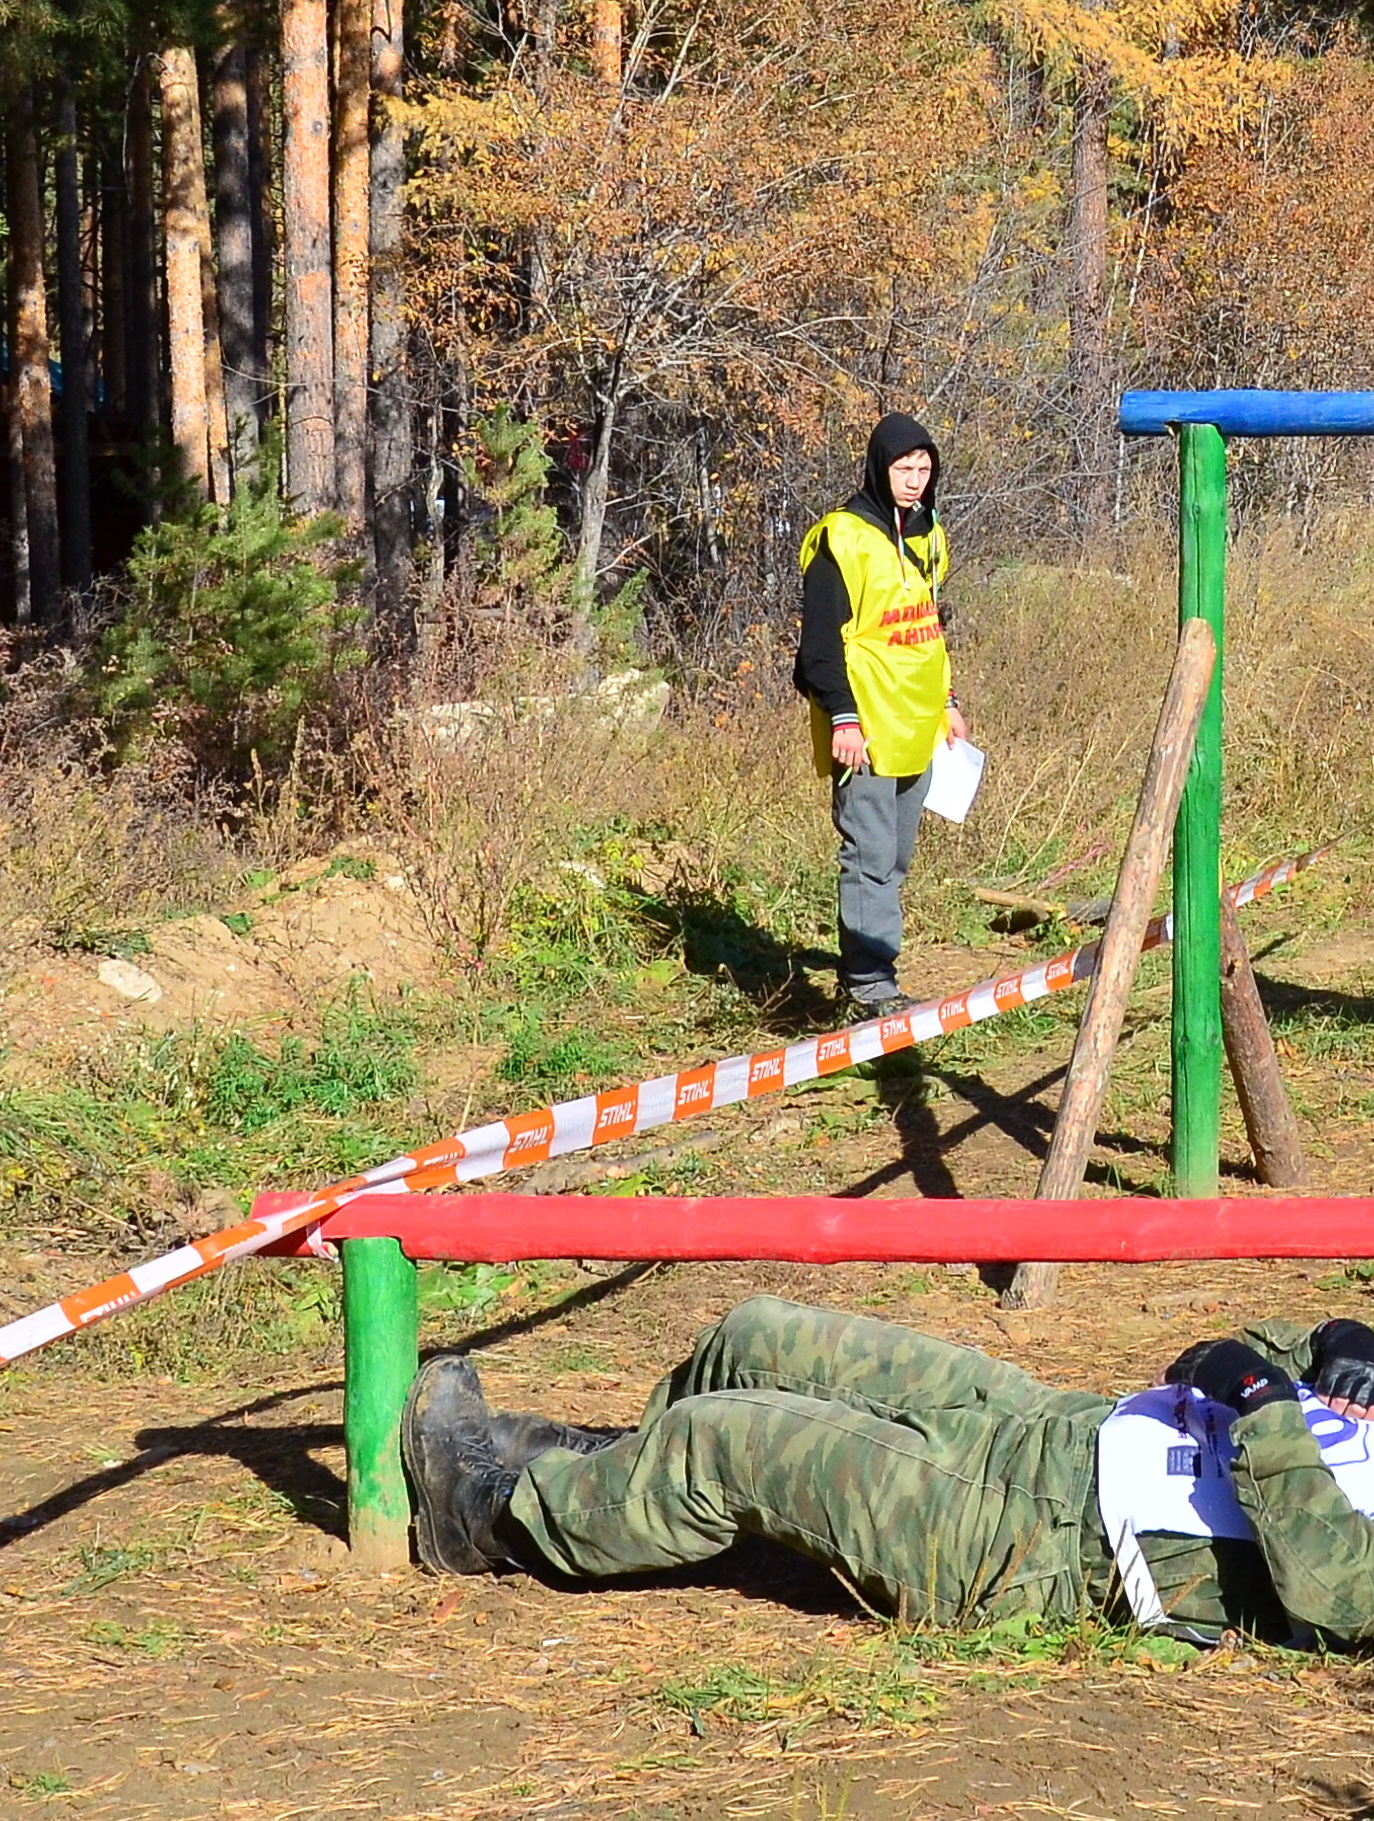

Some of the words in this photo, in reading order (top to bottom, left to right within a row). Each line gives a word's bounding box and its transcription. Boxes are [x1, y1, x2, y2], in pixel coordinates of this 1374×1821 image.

[818, 1039, 846, 1061] STIHL
[751, 1057, 782, 1082] STIHL
[678, 1079, 710, 1106] STIHL
[598, 1101, 634, 1128] STIHL
[508, 1125, 549, 1153] STIHL
